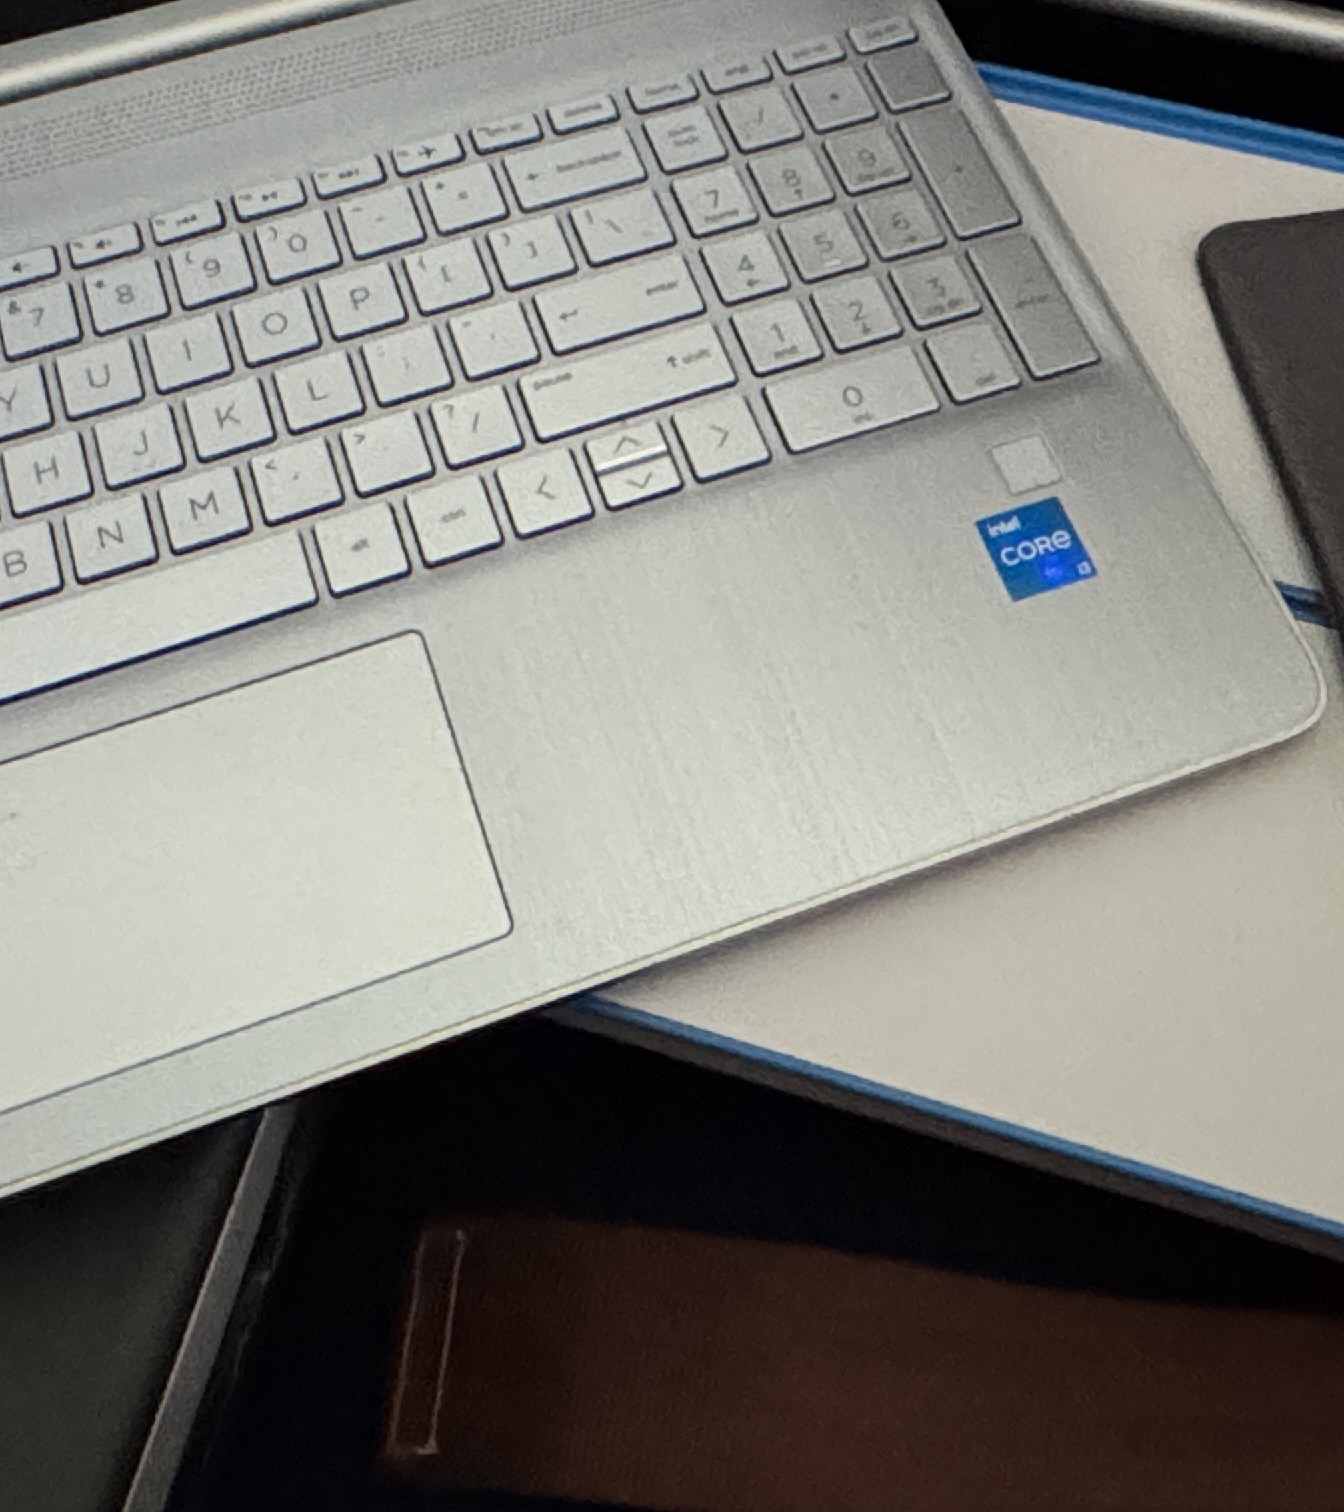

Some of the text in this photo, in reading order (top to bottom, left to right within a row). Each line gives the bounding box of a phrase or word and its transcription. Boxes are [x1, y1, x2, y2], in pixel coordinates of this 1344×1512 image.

[85, 364, 110, 389] U
[215, 403, 241, 429] K
[33, 458, 59, 484] H
[986, 515, 1023, 538] intel
